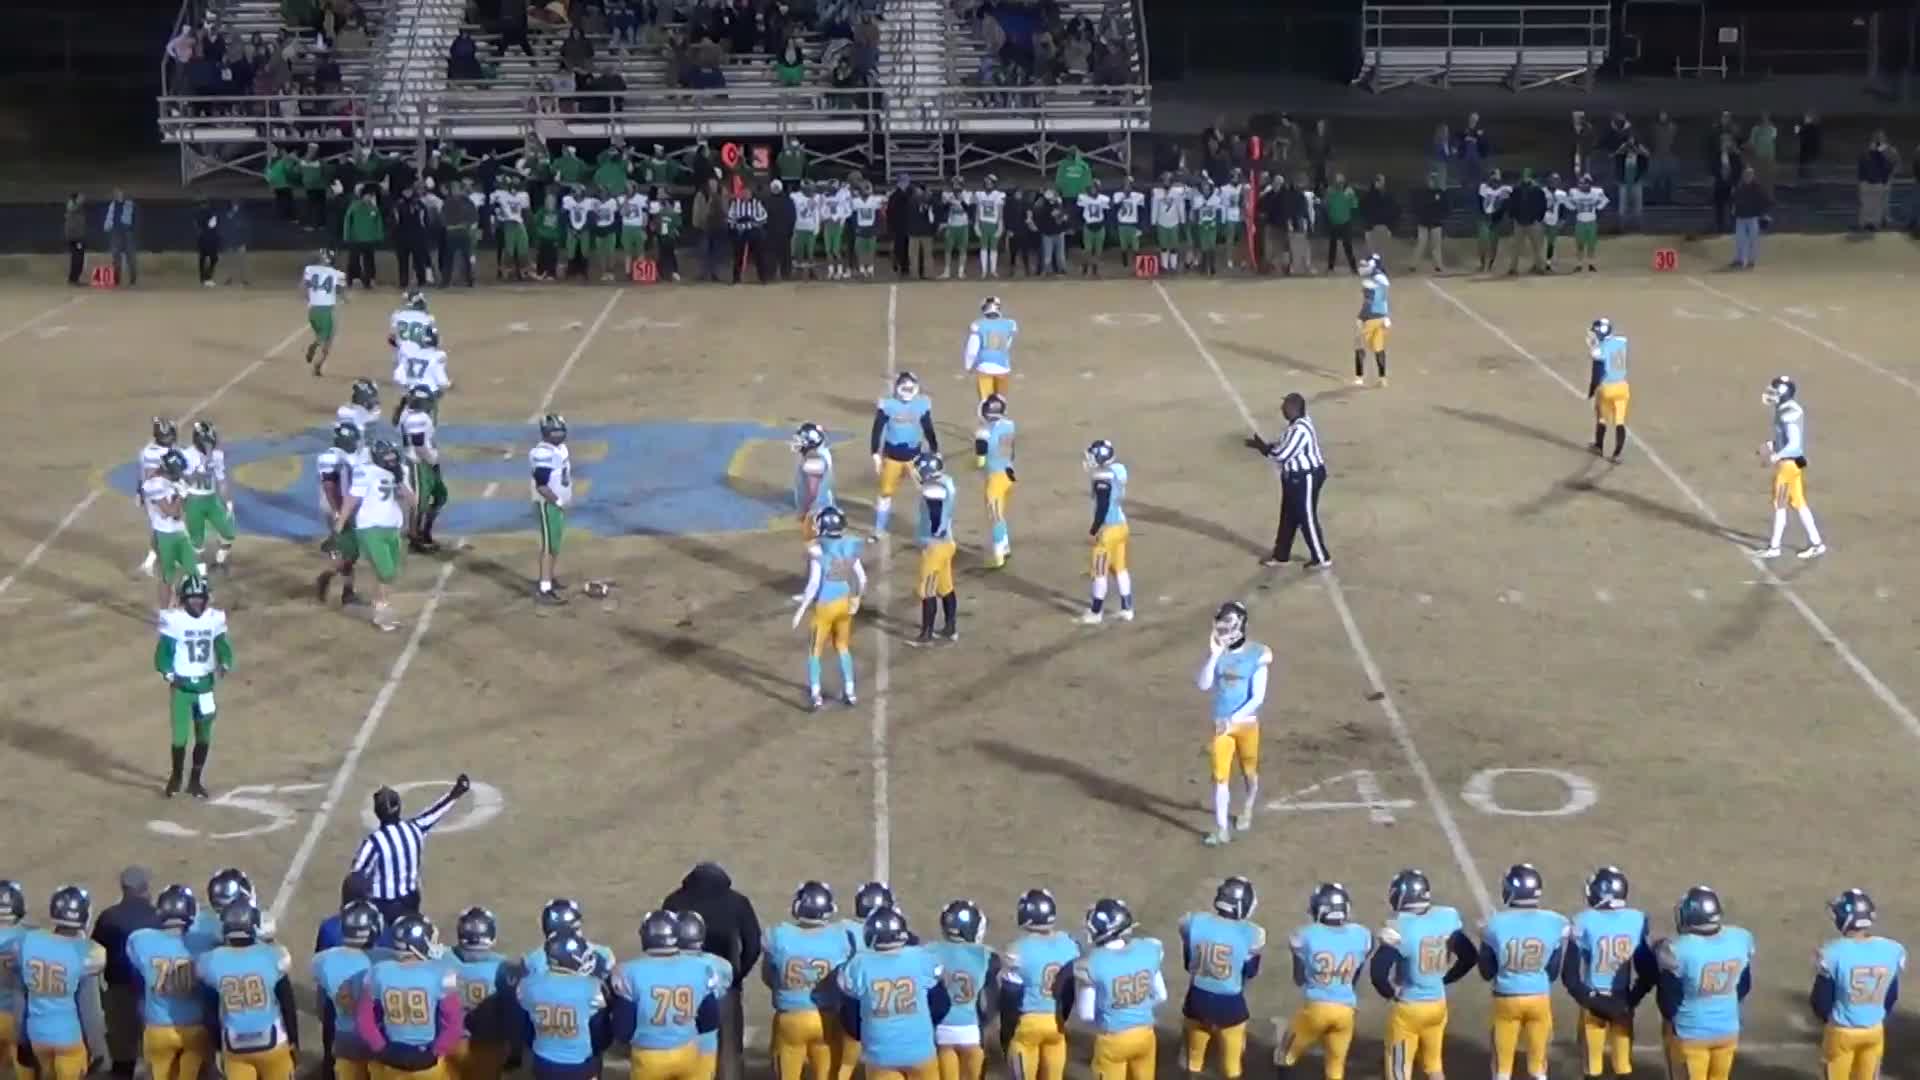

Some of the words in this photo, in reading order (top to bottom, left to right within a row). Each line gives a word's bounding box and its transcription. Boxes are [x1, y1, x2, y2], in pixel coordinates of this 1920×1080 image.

[93, 267, 112, 285] 40
[635, 262, 654, 281] 50
[1138, 257, 1155, 276] 40
[1656, 251, 1674, 270] 30
[311, 273, 333, 293] 44
[407, 358, 429, 379] 17
[184, 638, 211, 664] 13
[1197, 942, 1232, 979] 15
[1312, 952, 1355, 986] 34
[1504, 937, 1545, 971] 12
[220, 975, 265, 1010] 28
[1700, 960, 1740, 996] 67
[1850, 966, 1888, 1003] 57
[650, 985, 694, 1024] 79
[872, 977, 915, 1014] 72
